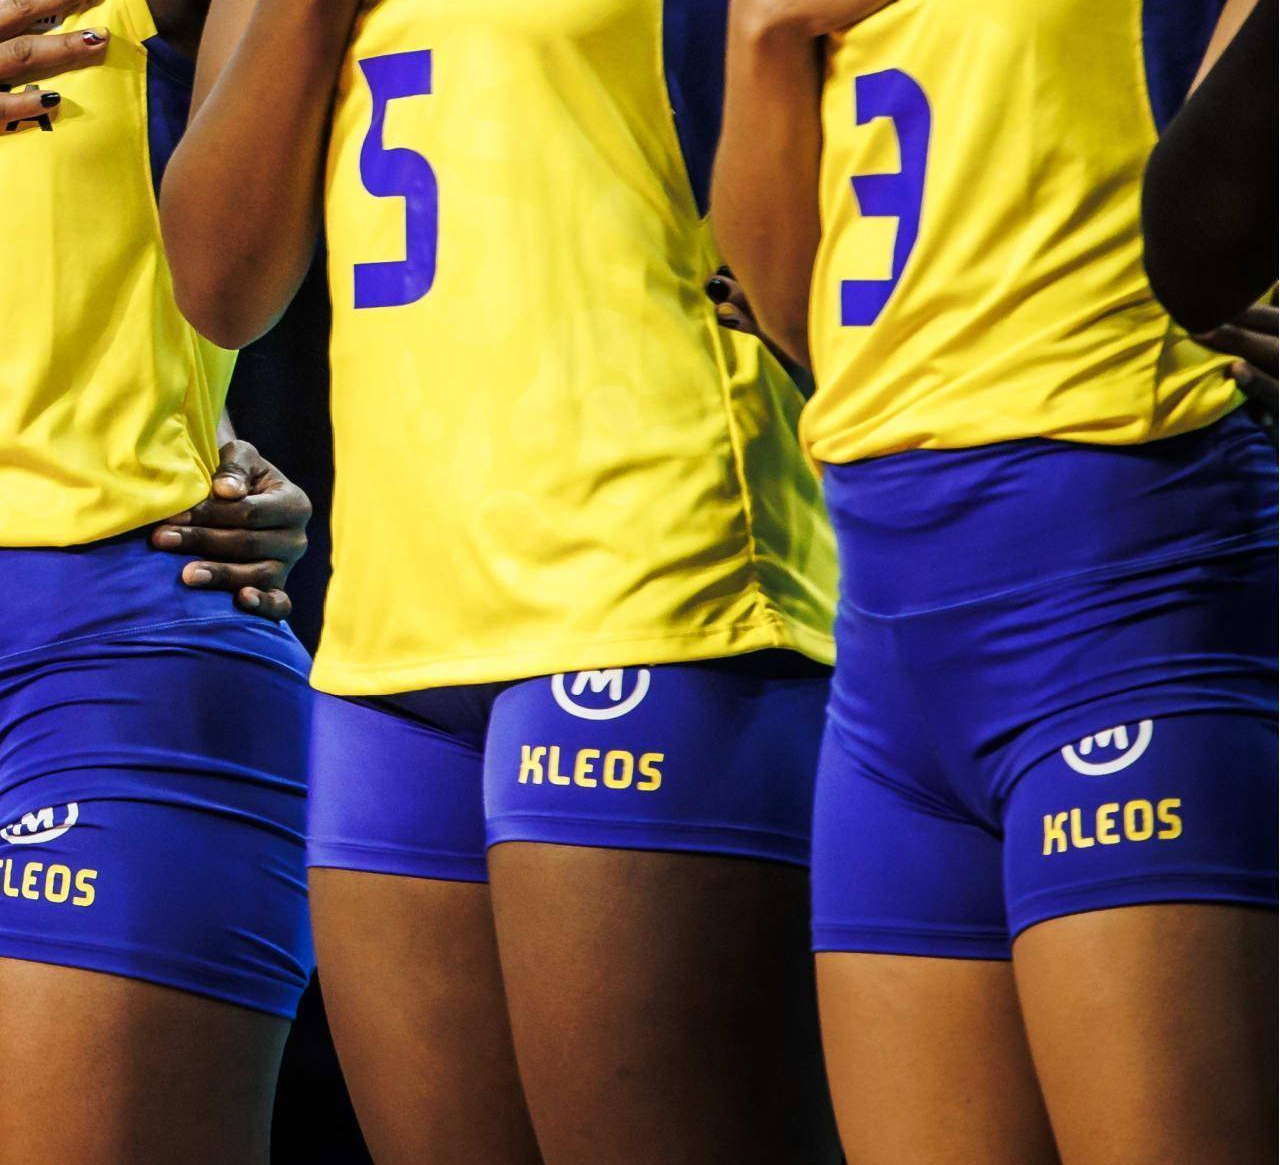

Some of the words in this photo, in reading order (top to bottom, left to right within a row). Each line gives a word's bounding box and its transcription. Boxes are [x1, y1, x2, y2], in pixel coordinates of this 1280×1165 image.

[352, 47, 440, 310] 5
[840, 67, 933, 327] 3
[517, 744, 665, 792] KLEOS
[1042, 797, 1183, 856] KLEOS
